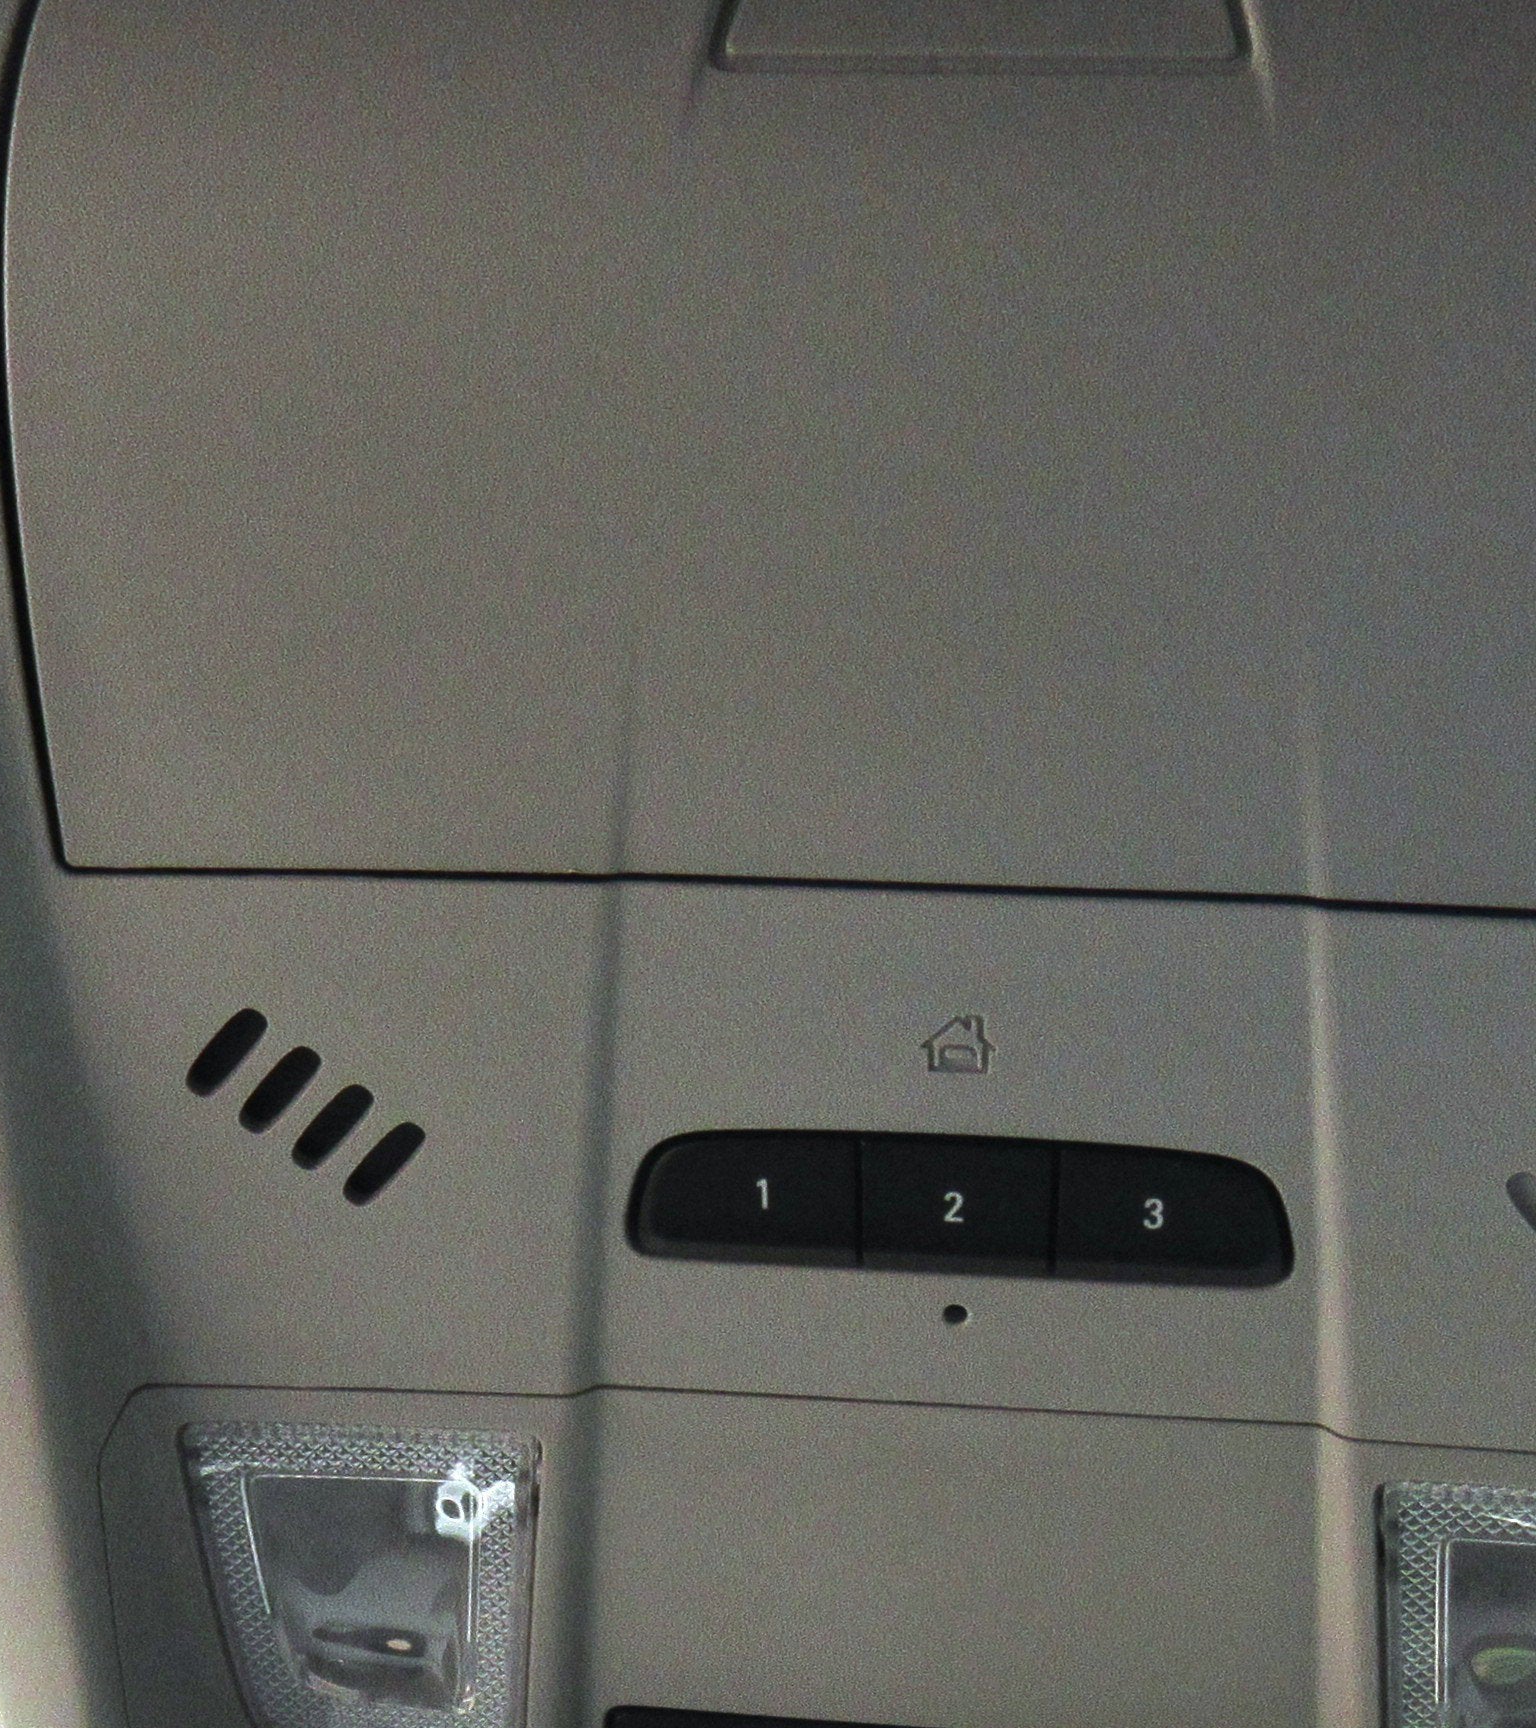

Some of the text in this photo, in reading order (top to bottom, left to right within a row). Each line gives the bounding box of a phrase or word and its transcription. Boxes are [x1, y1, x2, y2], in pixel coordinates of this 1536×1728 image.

[756, 1178, 1164, 1230] 1 2 3
